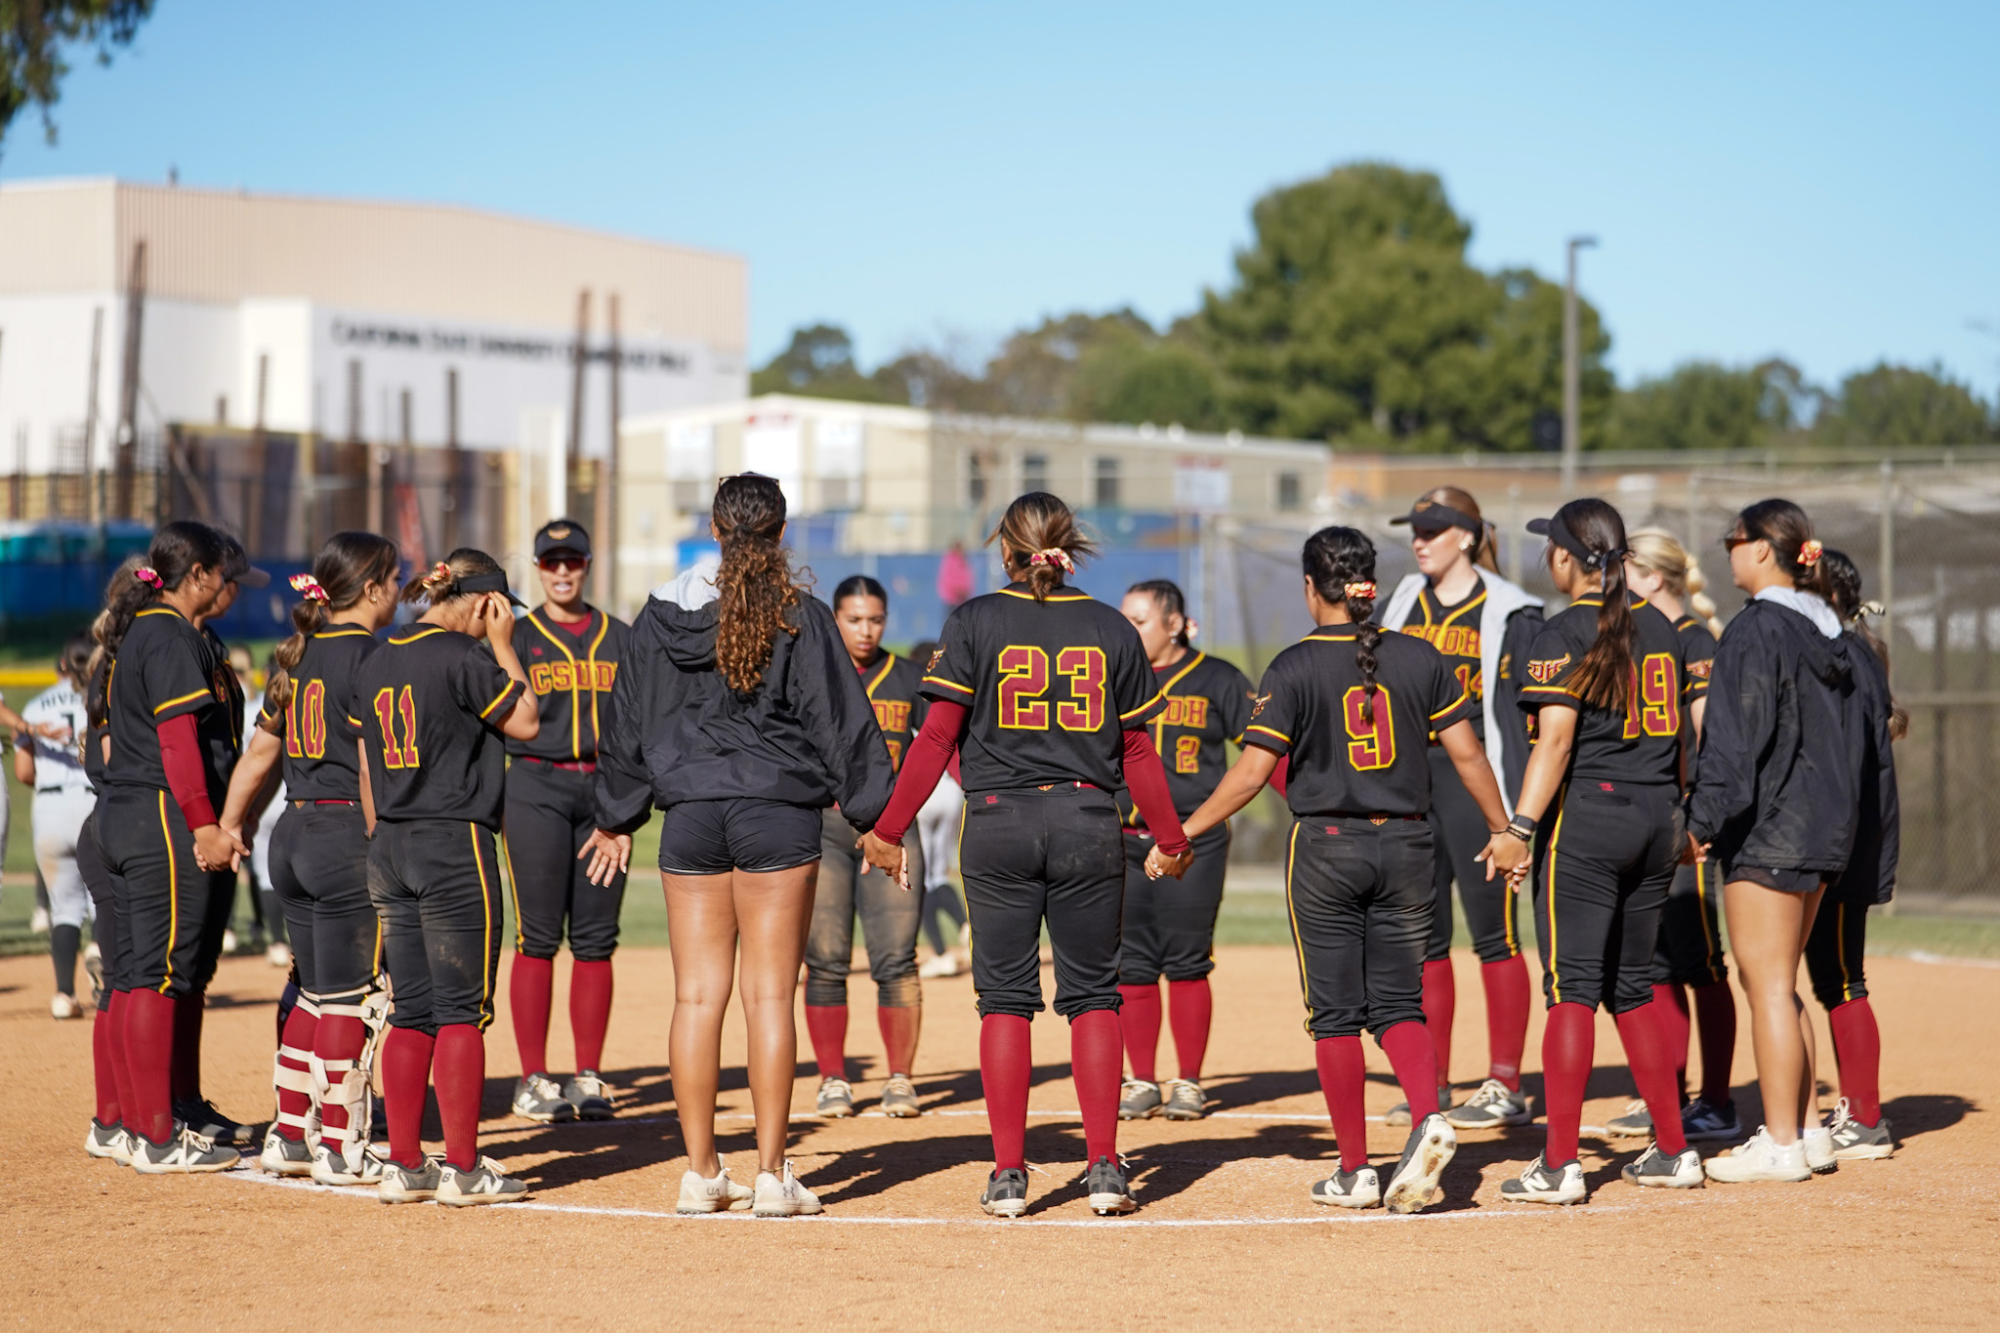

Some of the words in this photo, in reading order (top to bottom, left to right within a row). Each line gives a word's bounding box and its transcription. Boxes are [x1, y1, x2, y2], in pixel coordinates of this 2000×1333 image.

[285, 678, 326, 759] 10
[529, 660, 618, 695] CSUD
[998, 645, 1106, 732] 23
[1623, 652, 1680, 739] 19
[374, 684, 420, 769] 11
[1176, 735, 1201, 773] 2
[1343, 684, 1396, 771] 9
